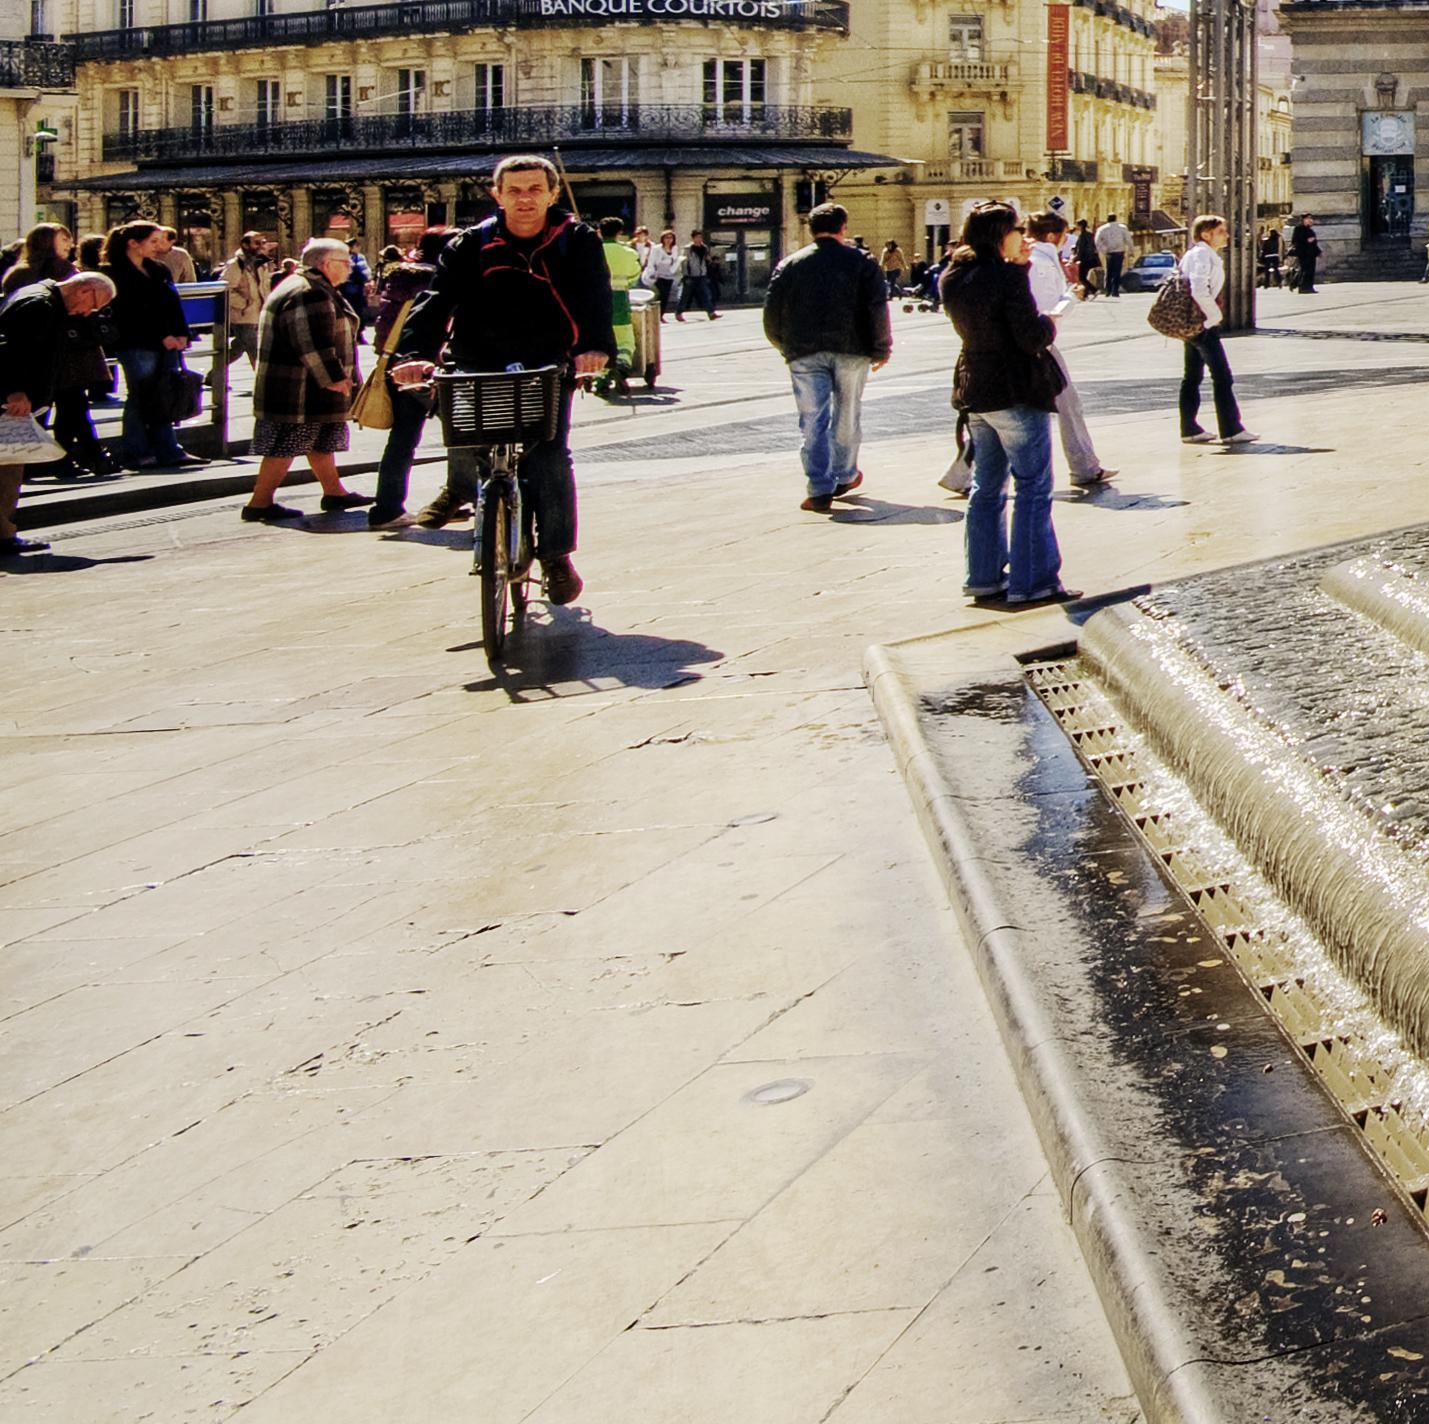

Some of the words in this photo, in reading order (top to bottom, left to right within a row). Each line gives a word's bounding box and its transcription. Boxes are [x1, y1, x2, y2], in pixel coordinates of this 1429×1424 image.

[1051, 17, 1065, 44] MIDI
[1051, 69, 1065, 106] HOTEL
[1051, 112, 1065, 137] NEW
[718, 206, 770, 218] change
